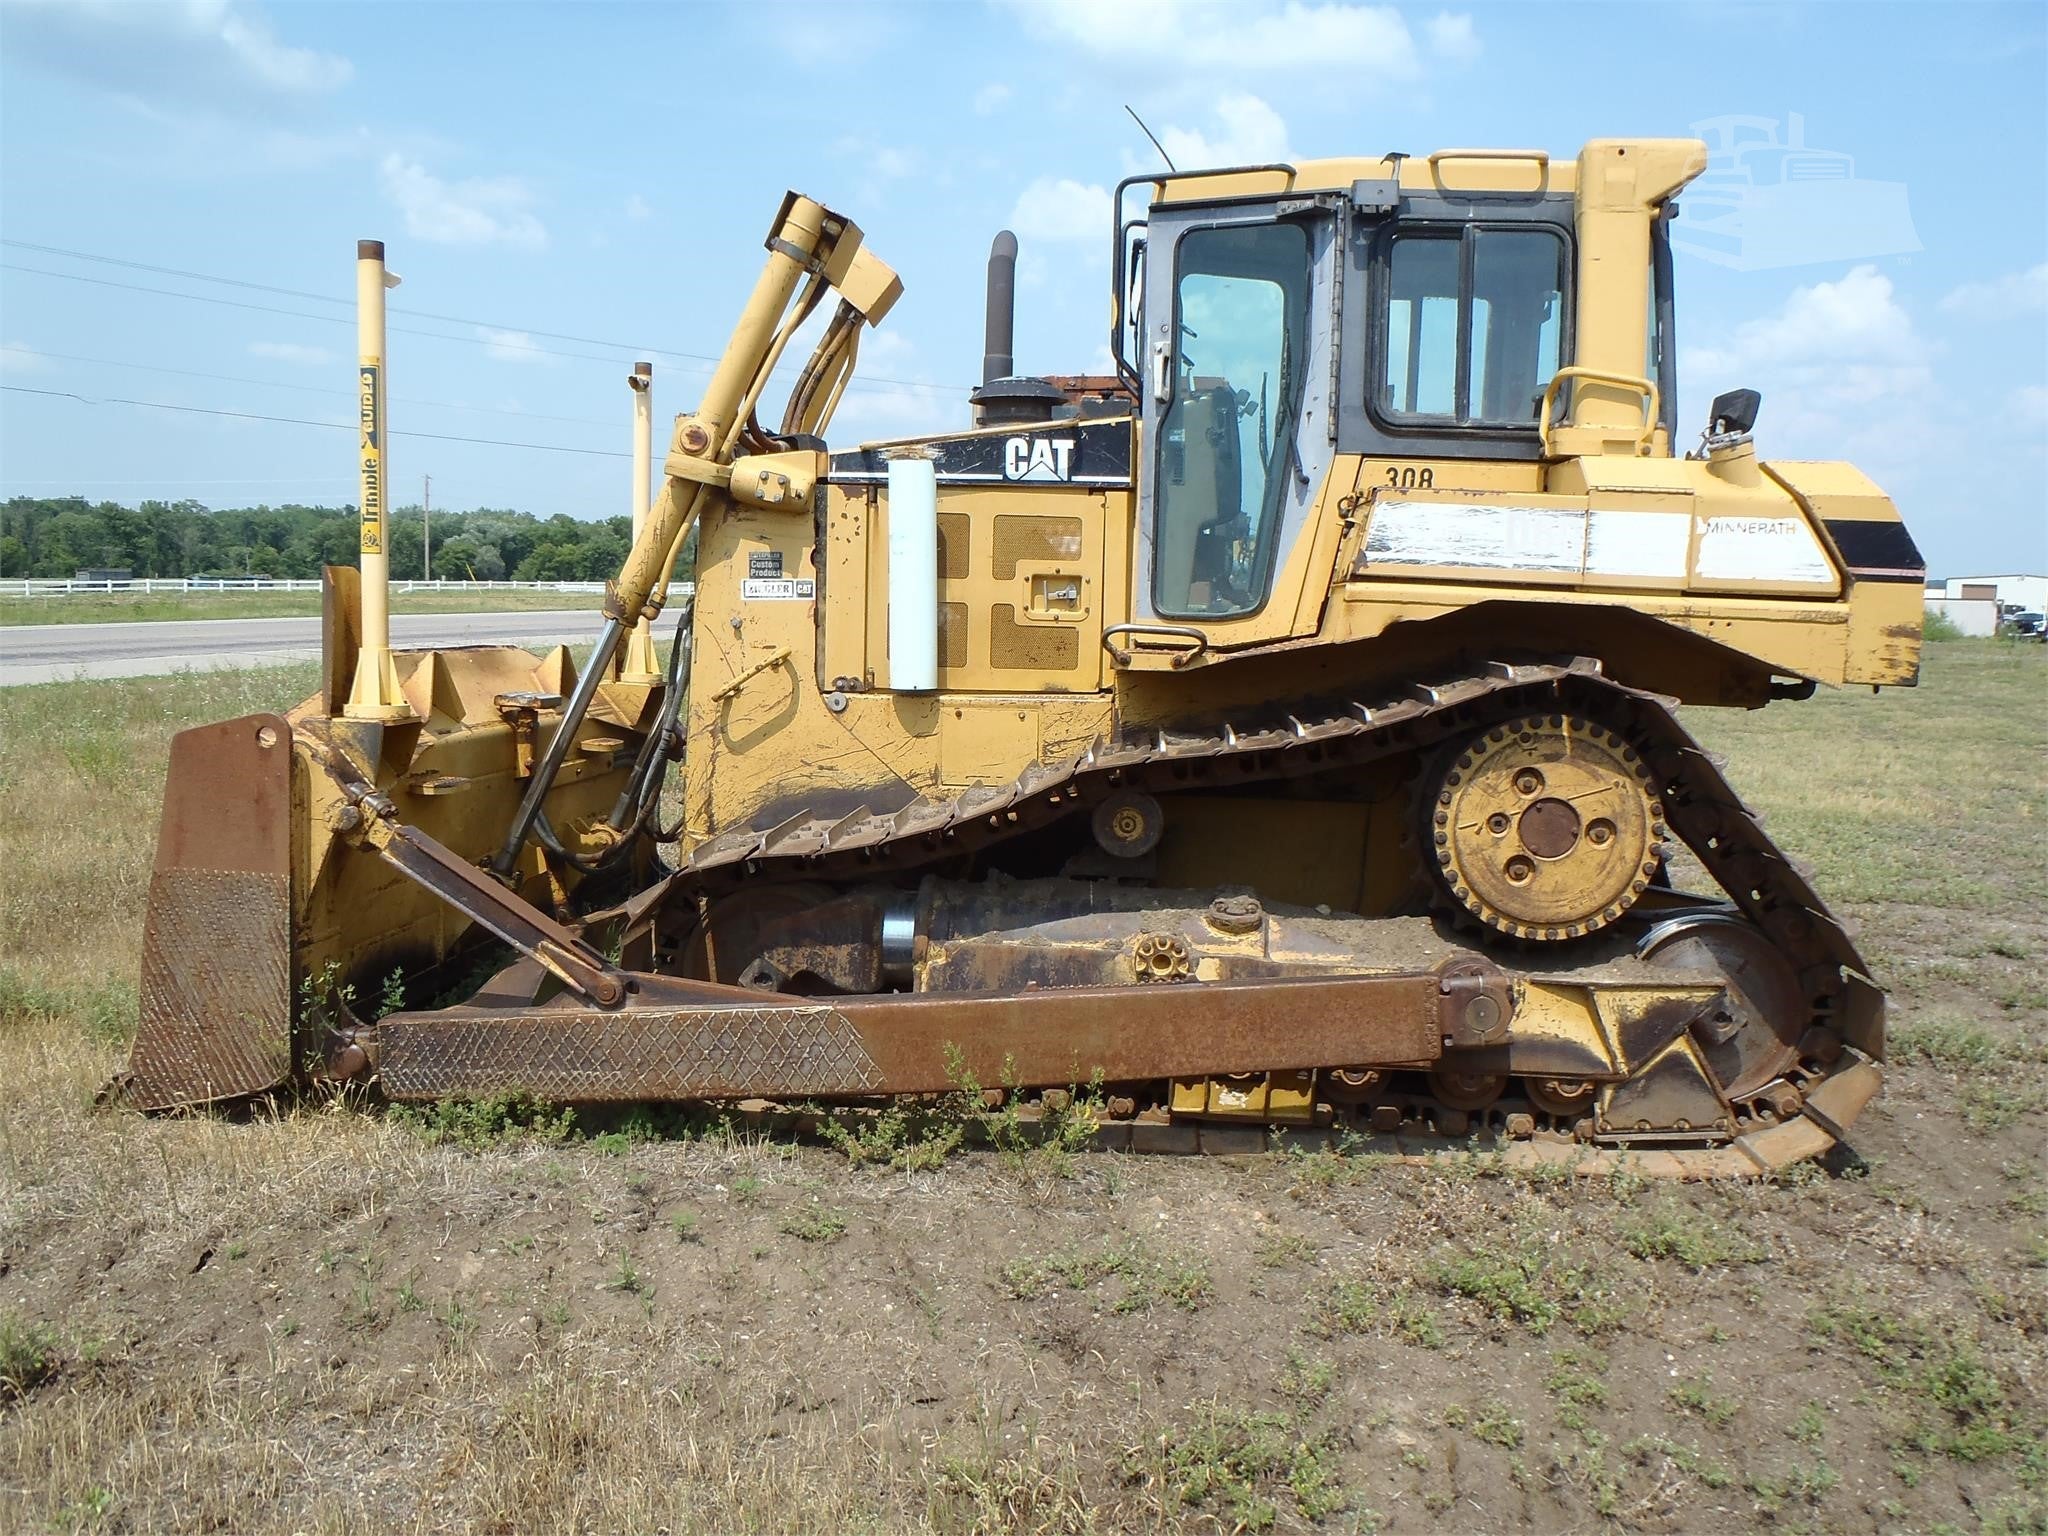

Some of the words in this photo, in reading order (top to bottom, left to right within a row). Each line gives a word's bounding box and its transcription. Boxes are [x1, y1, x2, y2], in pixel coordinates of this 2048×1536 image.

[1005, 438, 1075, 482] CAT
[1386, 467, 1433, 488] 308
[361, 458, 378, 525] Trimble
[1707, 522, 1797, 535] MINNERATH
[750, 560, 780, 569] Custom
[750, 568, 781, 577] Product
[797, 584, 812, 594] CAT
